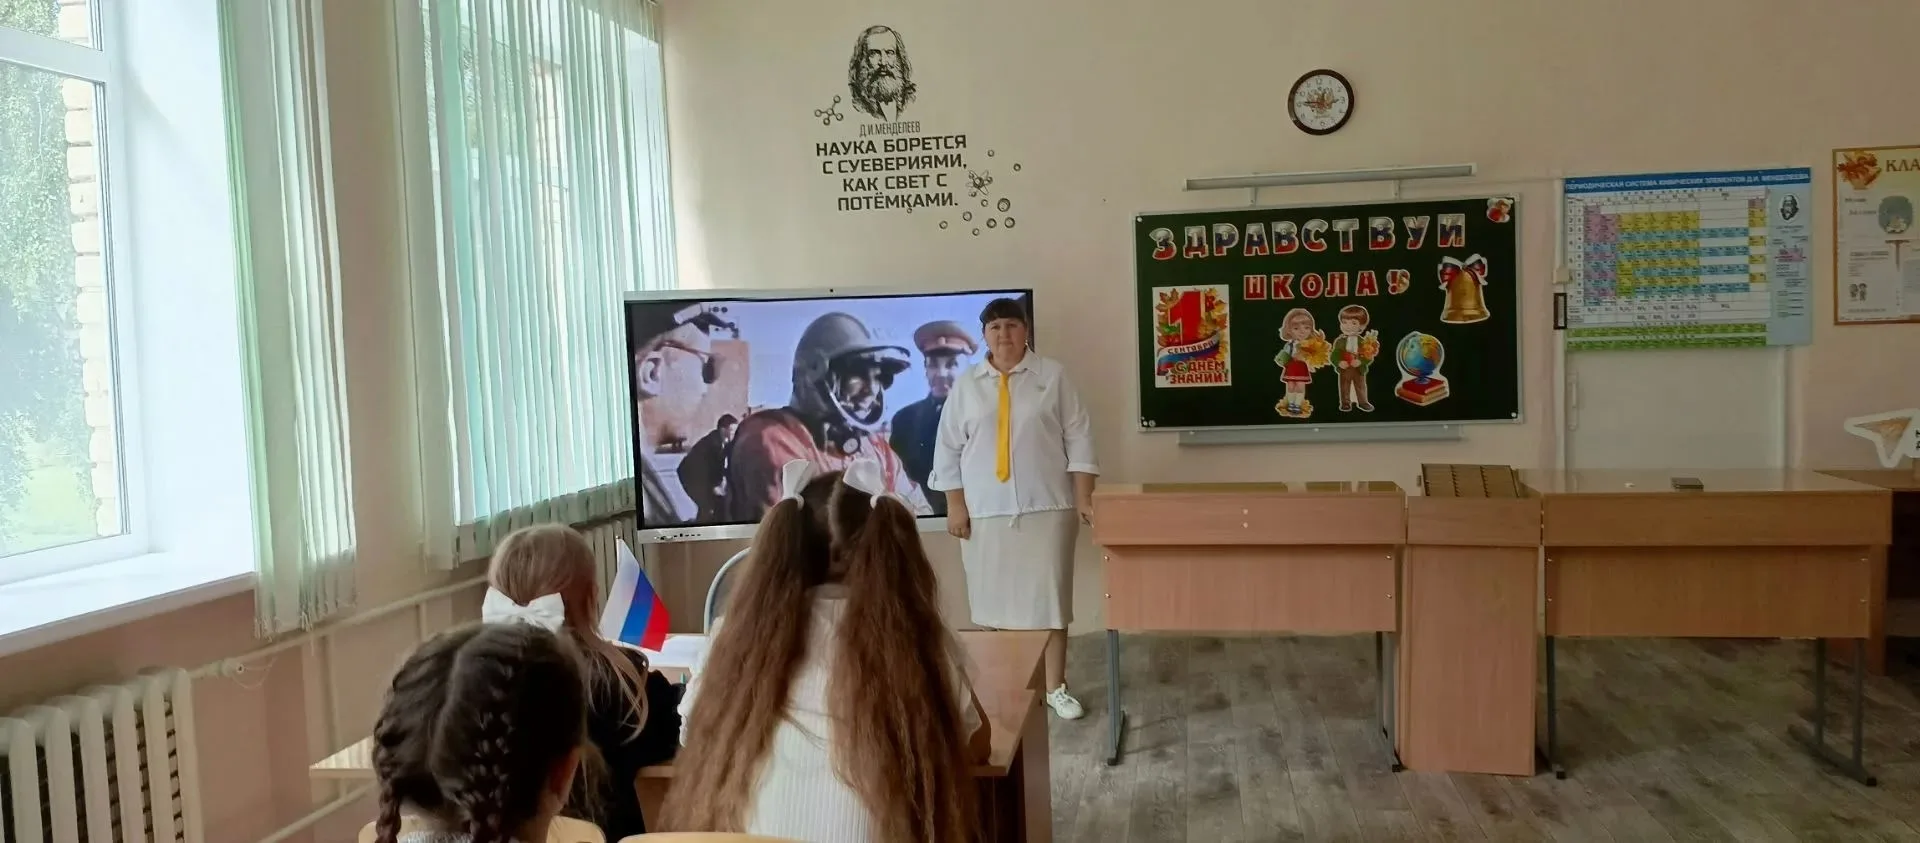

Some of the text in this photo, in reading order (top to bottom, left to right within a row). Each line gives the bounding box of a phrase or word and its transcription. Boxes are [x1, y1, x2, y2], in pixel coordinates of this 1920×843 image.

[875, 120, 920, 136] МЕНДЕЛЕЕВ
[816, 135, 966, 157] НАУКА БОРЕТСЯ
[822, 154, 967, 174] С СУЕВЕРИЯМИ,
[843, 173, 947, 192] КАК СВЕТ С
[838, 192, 958, 211] ПОТЁМКАМИ.
